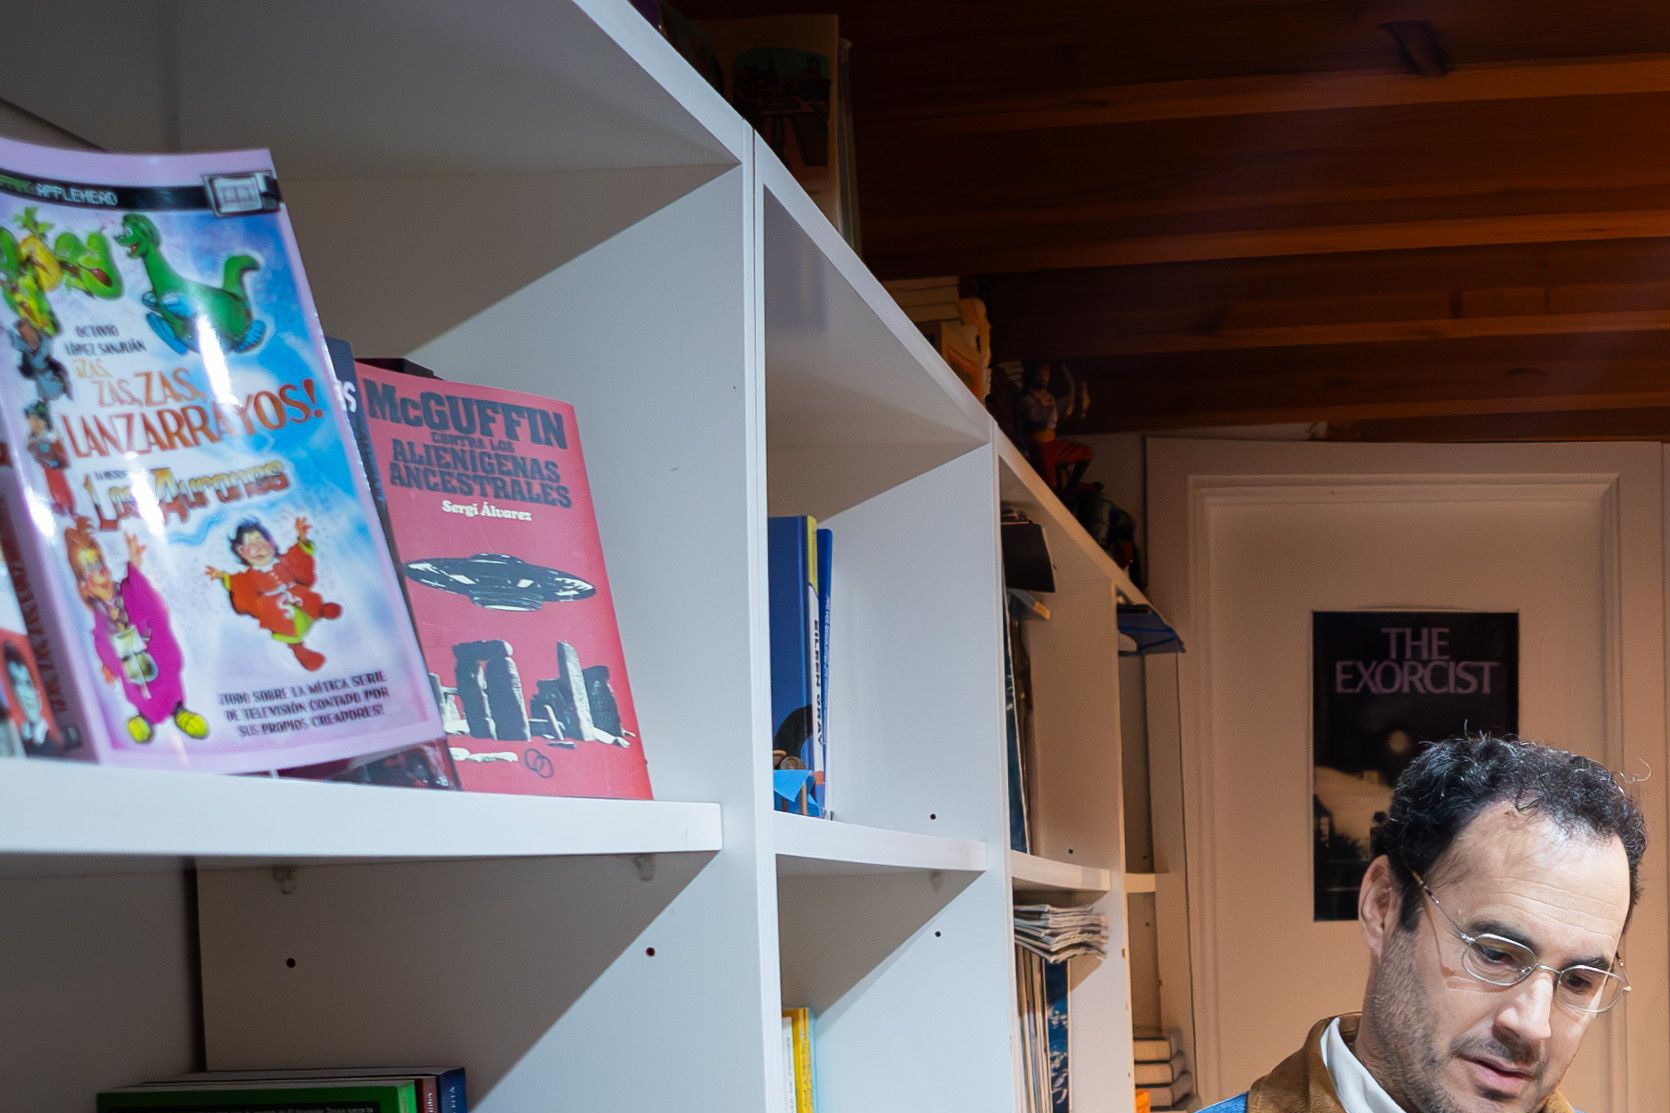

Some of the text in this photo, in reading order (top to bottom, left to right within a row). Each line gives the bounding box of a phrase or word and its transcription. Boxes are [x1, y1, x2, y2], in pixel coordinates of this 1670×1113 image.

[362, 377, 568, 450] McGUFFIN
[389, 460, 574, 510] ANCESTRALES
[441, 499, 533, 522] Sergi Álvarez
[814, 619, 822, 687] EILEEN
[1381, 626, 1451, 661] THE
[1335, 659, 1500, 694] EXORCIST
